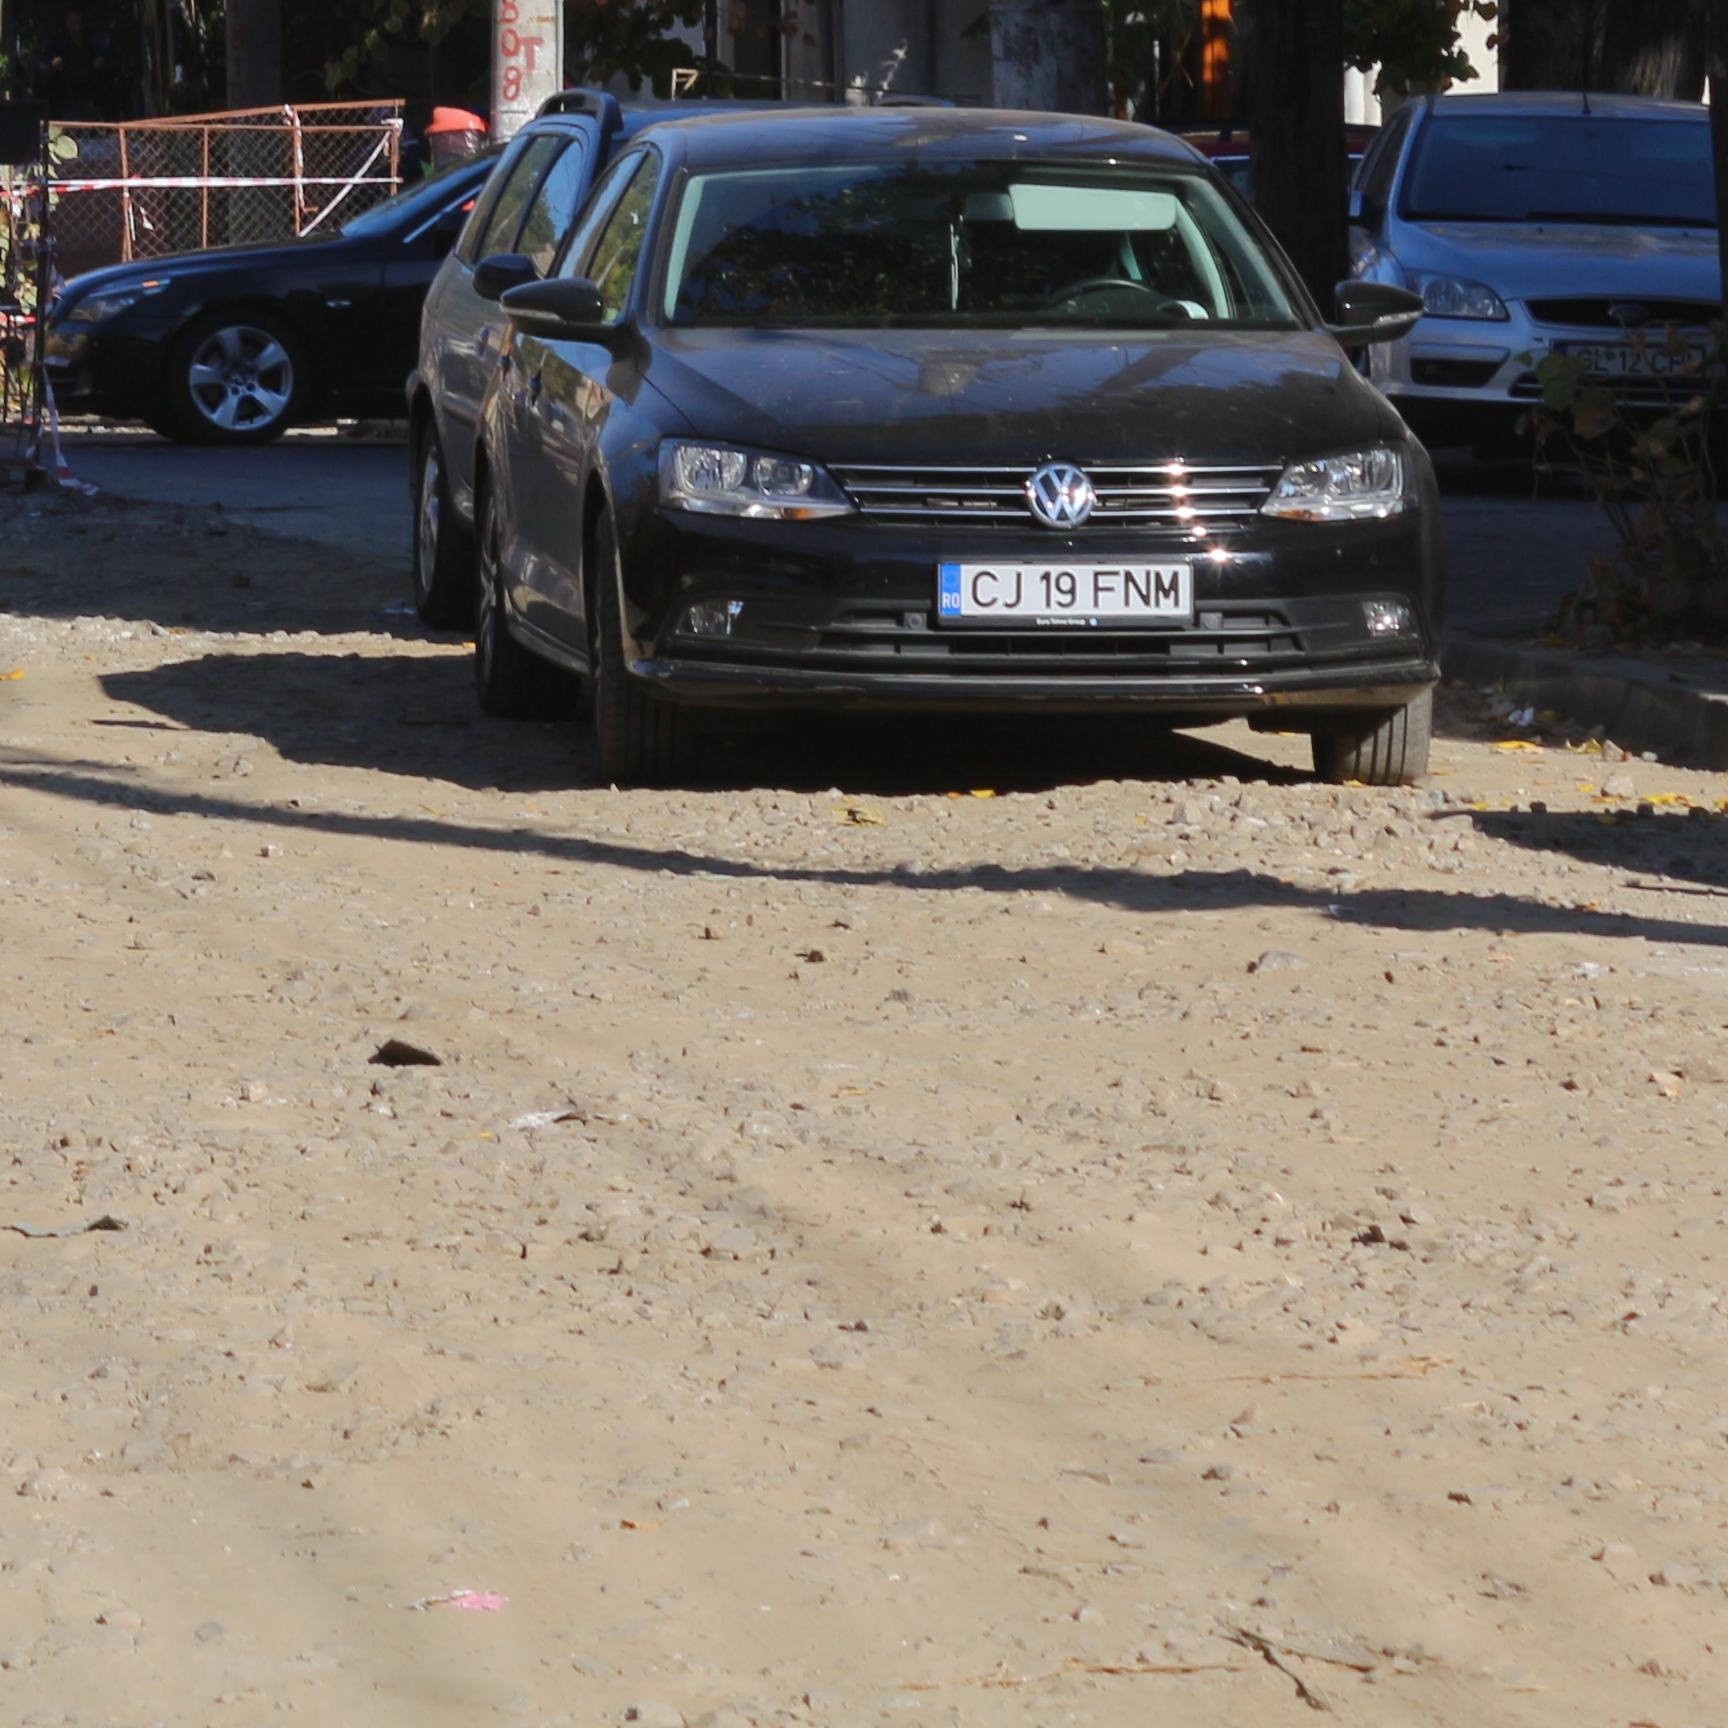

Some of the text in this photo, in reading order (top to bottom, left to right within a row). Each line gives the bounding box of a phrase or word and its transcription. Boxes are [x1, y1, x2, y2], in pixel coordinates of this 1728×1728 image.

[942, 592, 960, 609] RO
[971, 570, 1180, 608] CJ 19 FNM
